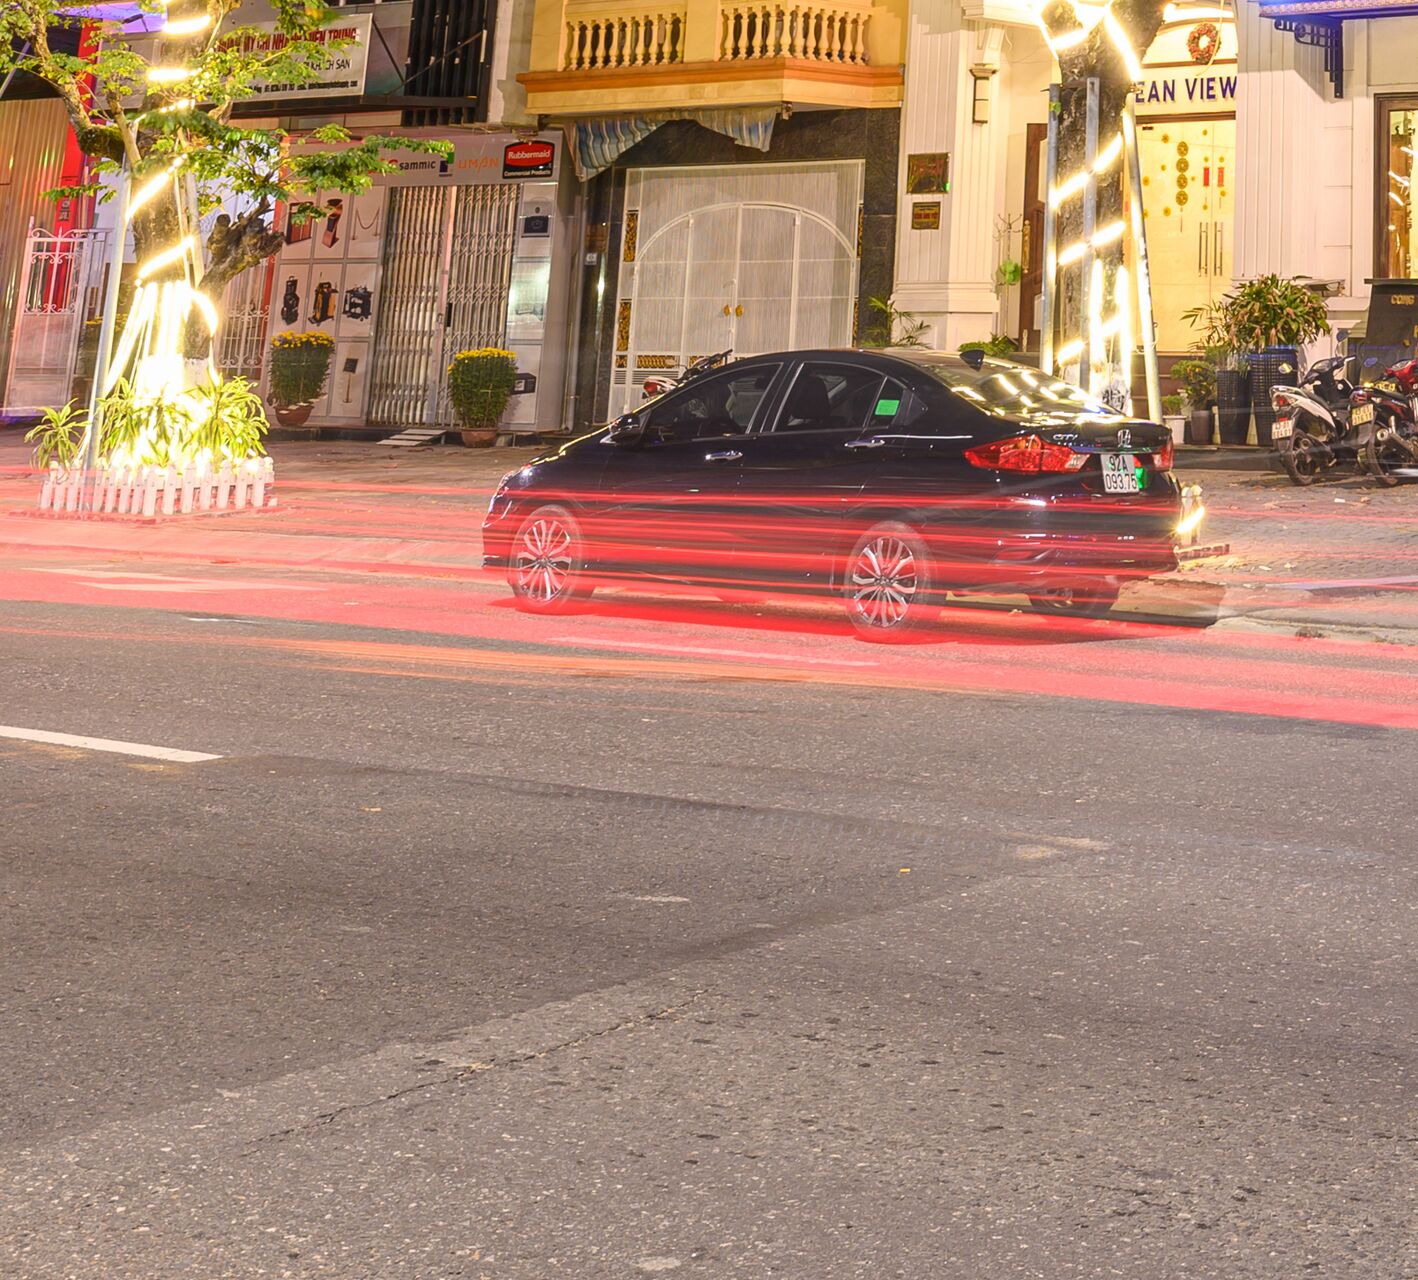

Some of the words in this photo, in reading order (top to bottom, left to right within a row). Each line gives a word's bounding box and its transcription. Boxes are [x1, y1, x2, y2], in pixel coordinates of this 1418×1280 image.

[1136, 80, 1176, 103] EAN
[1185, 76, 1238, 101] VIEW
[508, 149, 551, 160] Rubbermaid
[400, 160, 437, 171] sammic
[1109, 455, 1128, 471] 92A
[1105, 473, 1137, 491] 093.75
